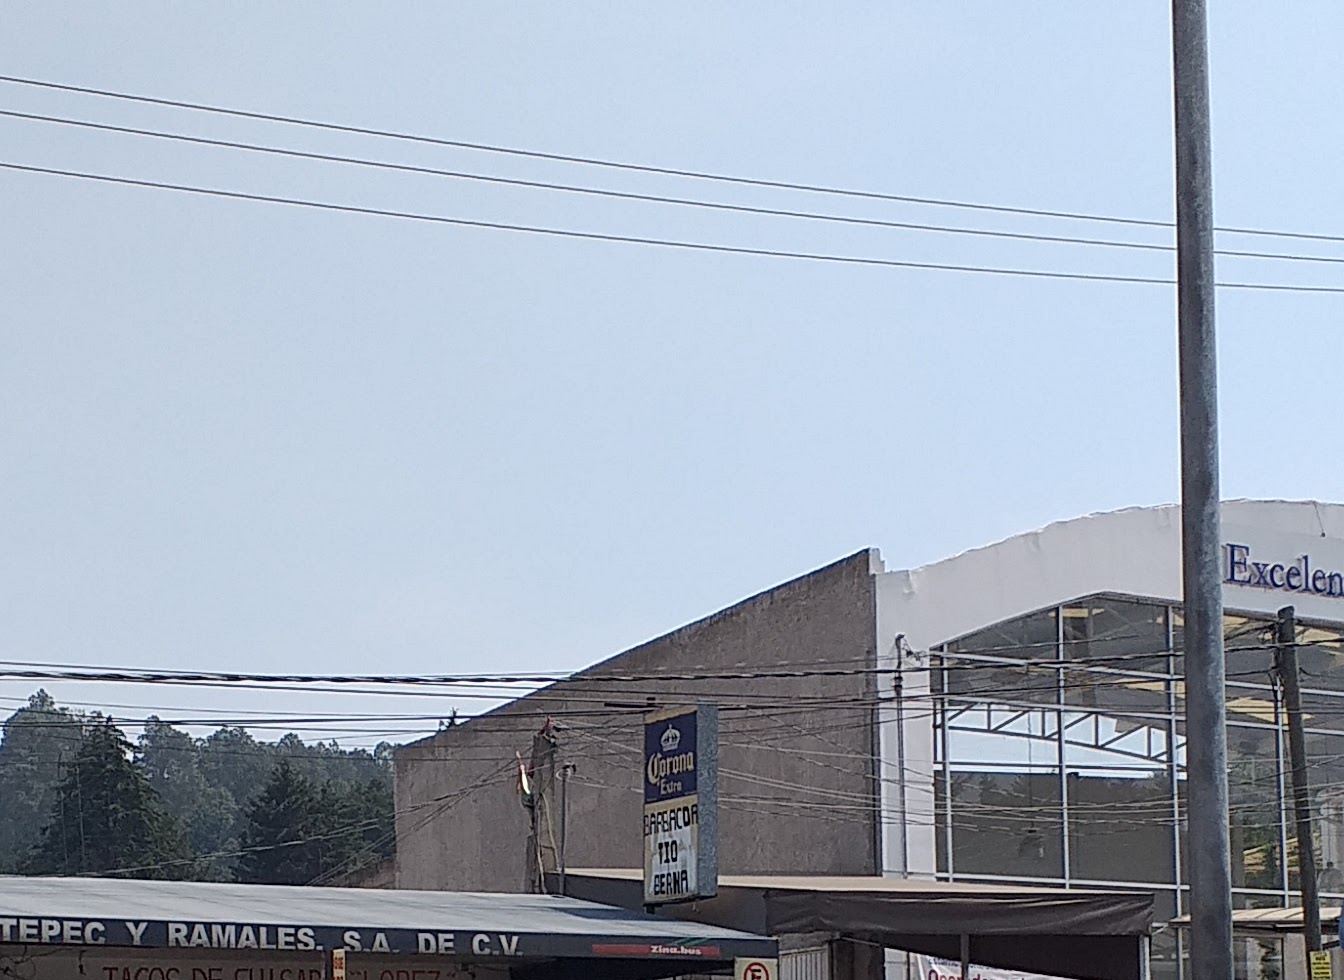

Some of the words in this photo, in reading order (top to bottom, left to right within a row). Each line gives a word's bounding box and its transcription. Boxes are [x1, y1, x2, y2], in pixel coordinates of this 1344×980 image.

[647, 751, 695, 785] Corona
[660, 778, 683, 796] Extra
[658, 839, 678, 864] TIO
[654, 869, 689, 896] BERNA
[125, 921, 149, 946] Y
[342, 930, 400, 952] S.A.
[418, 933, 456, 954] DE
[471, 934, 524, 956] C.V.
